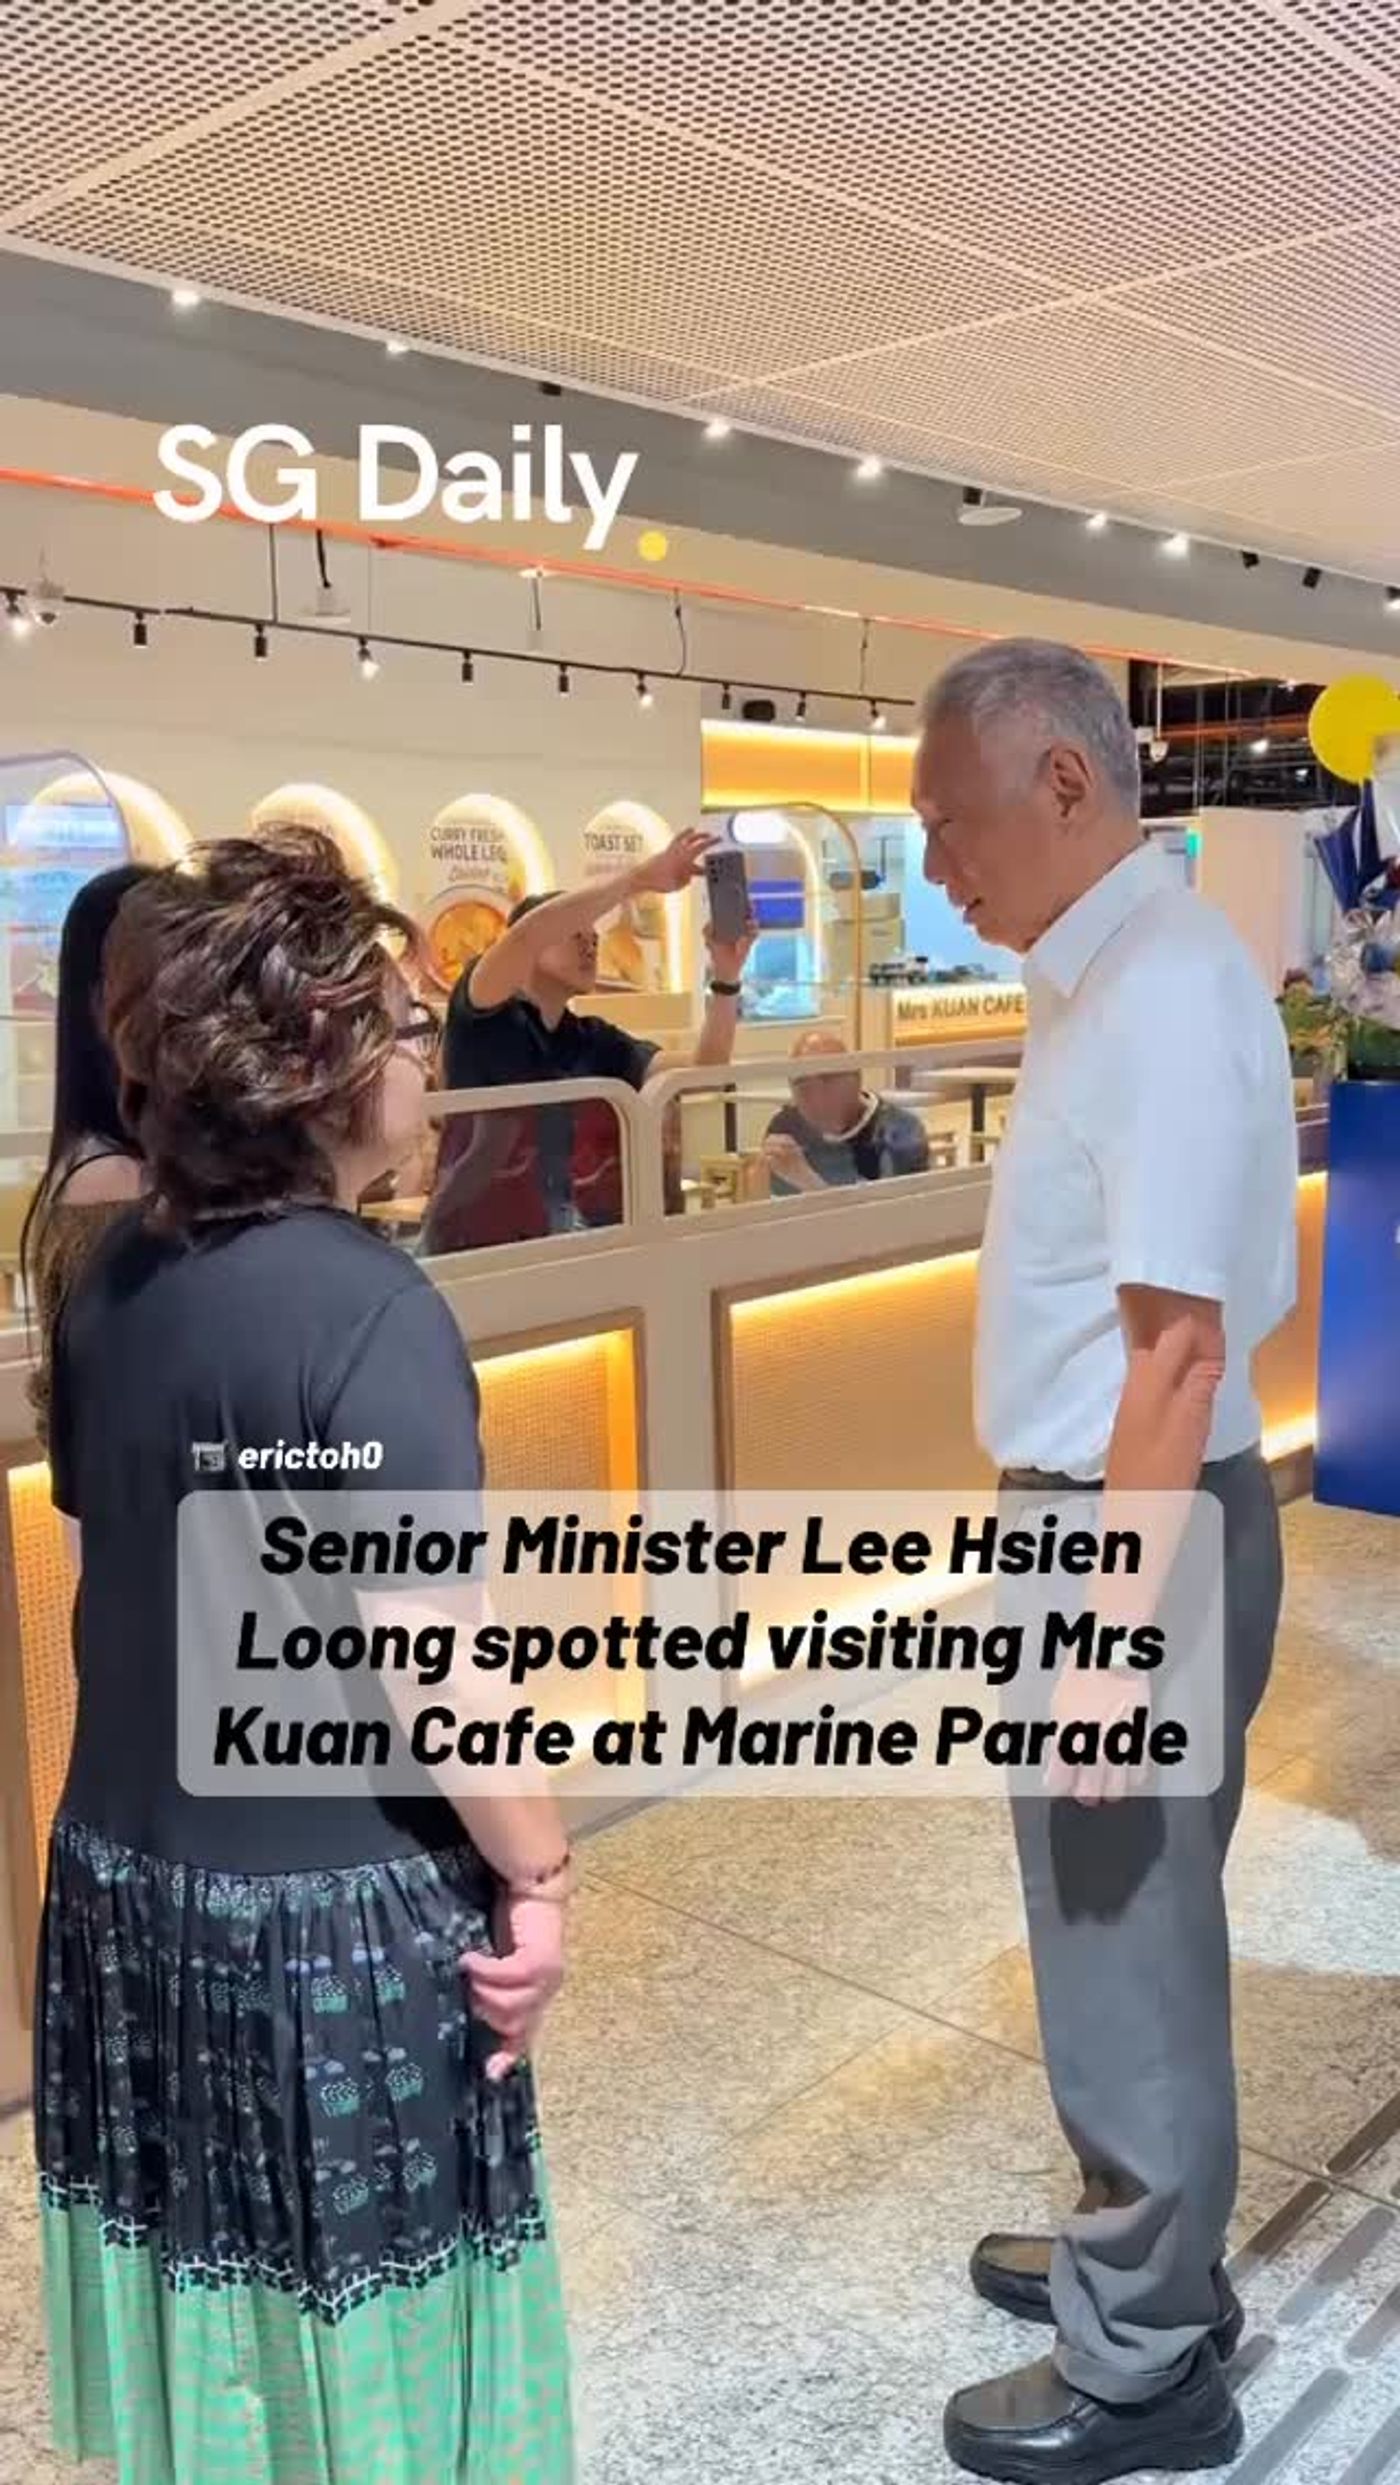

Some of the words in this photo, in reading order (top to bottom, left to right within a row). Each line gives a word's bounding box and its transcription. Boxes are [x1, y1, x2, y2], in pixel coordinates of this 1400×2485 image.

[430, 826, 466, 842] CURRY
[583, 831, 621, 852] TOAST
[431, 843, 478, 861] WHOLE
[897, 998, 928, 1019] Mrs
[932, 996, 980, 1018] KUAN
[982, 992, 1025, 1015] CAFE
